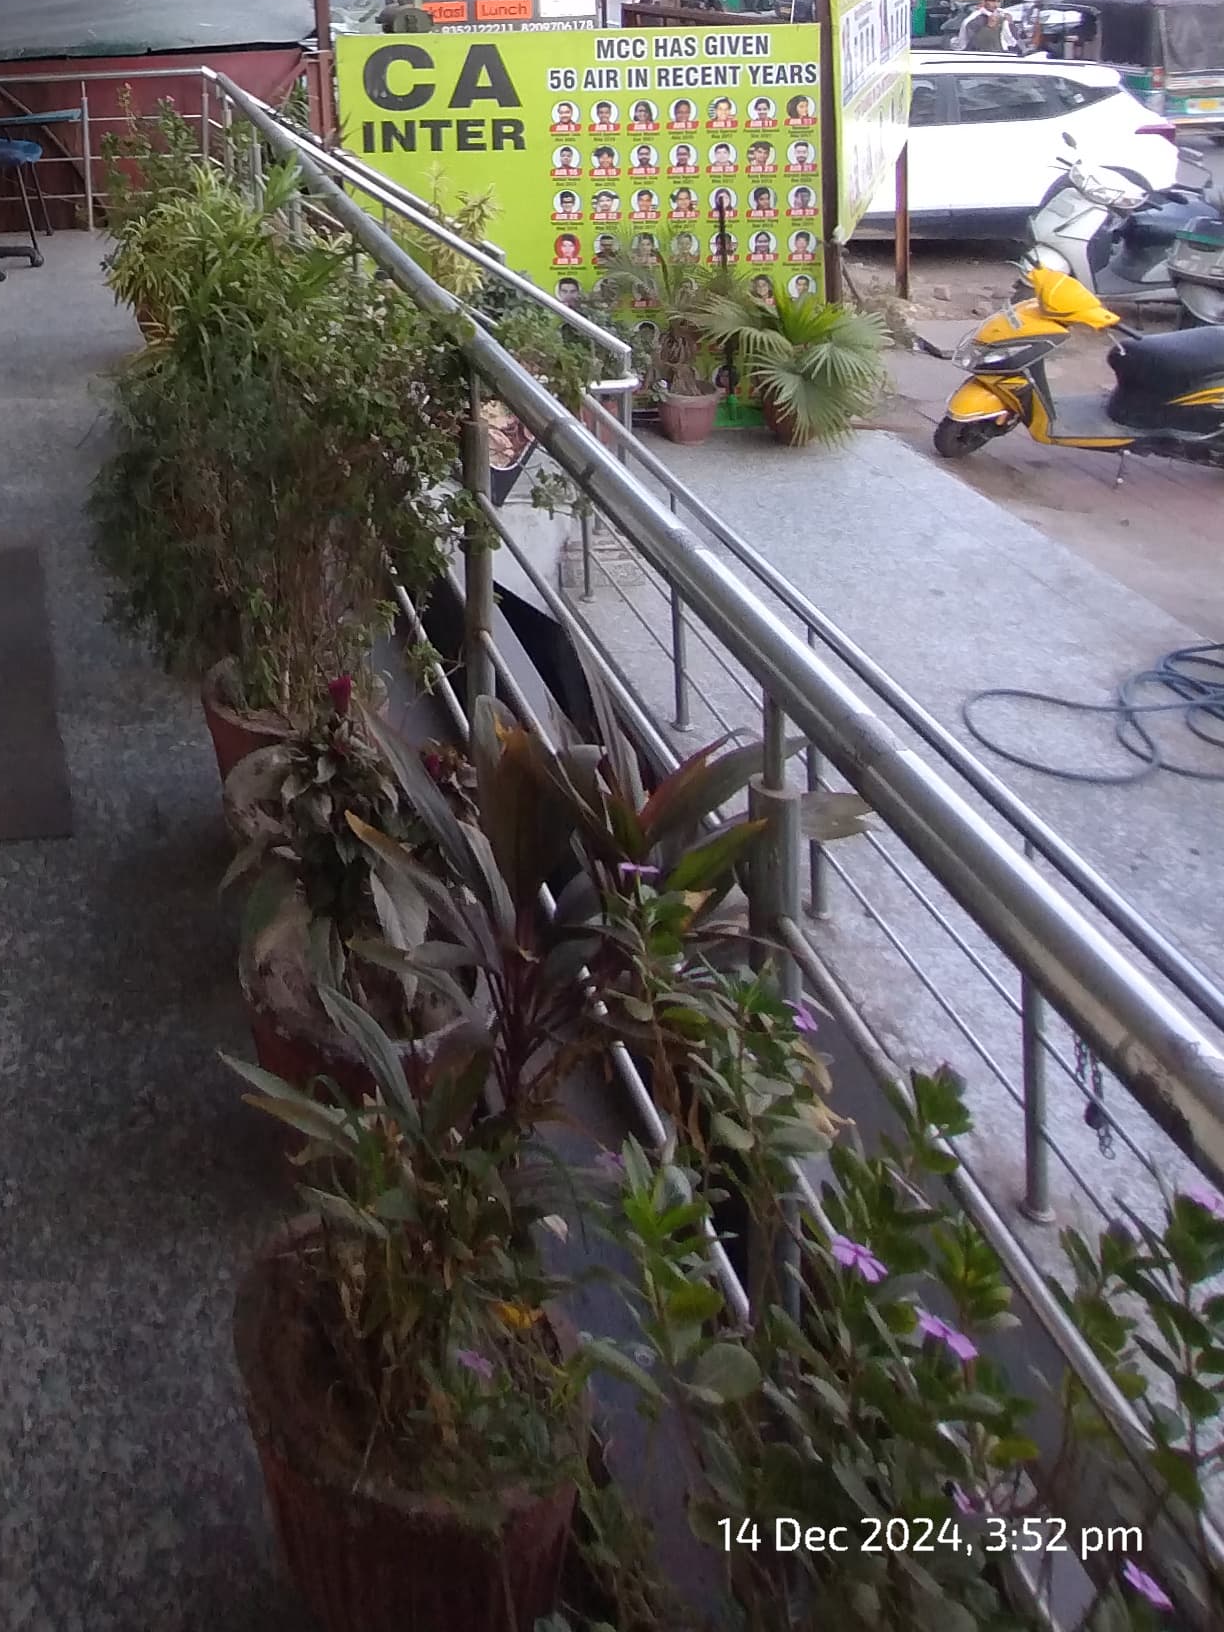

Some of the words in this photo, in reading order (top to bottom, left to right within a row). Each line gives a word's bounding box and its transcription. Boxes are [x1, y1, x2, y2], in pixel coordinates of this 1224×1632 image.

[482, 2, 527, 17] Lunch
[596, 38, 645, 59] MCC
[654, 37, 697, 58] HAS
[704, 35, 769, 56] GIVEN
[549, 69, 575, 89] 56
[583, 68, 619, 89] AIR
[627, 68, 648, 88] IN
[657, 65, 741, 87] RECENT
[748, 63, 817, 85] YEARS
[363, 119, 525, 153] INTER
